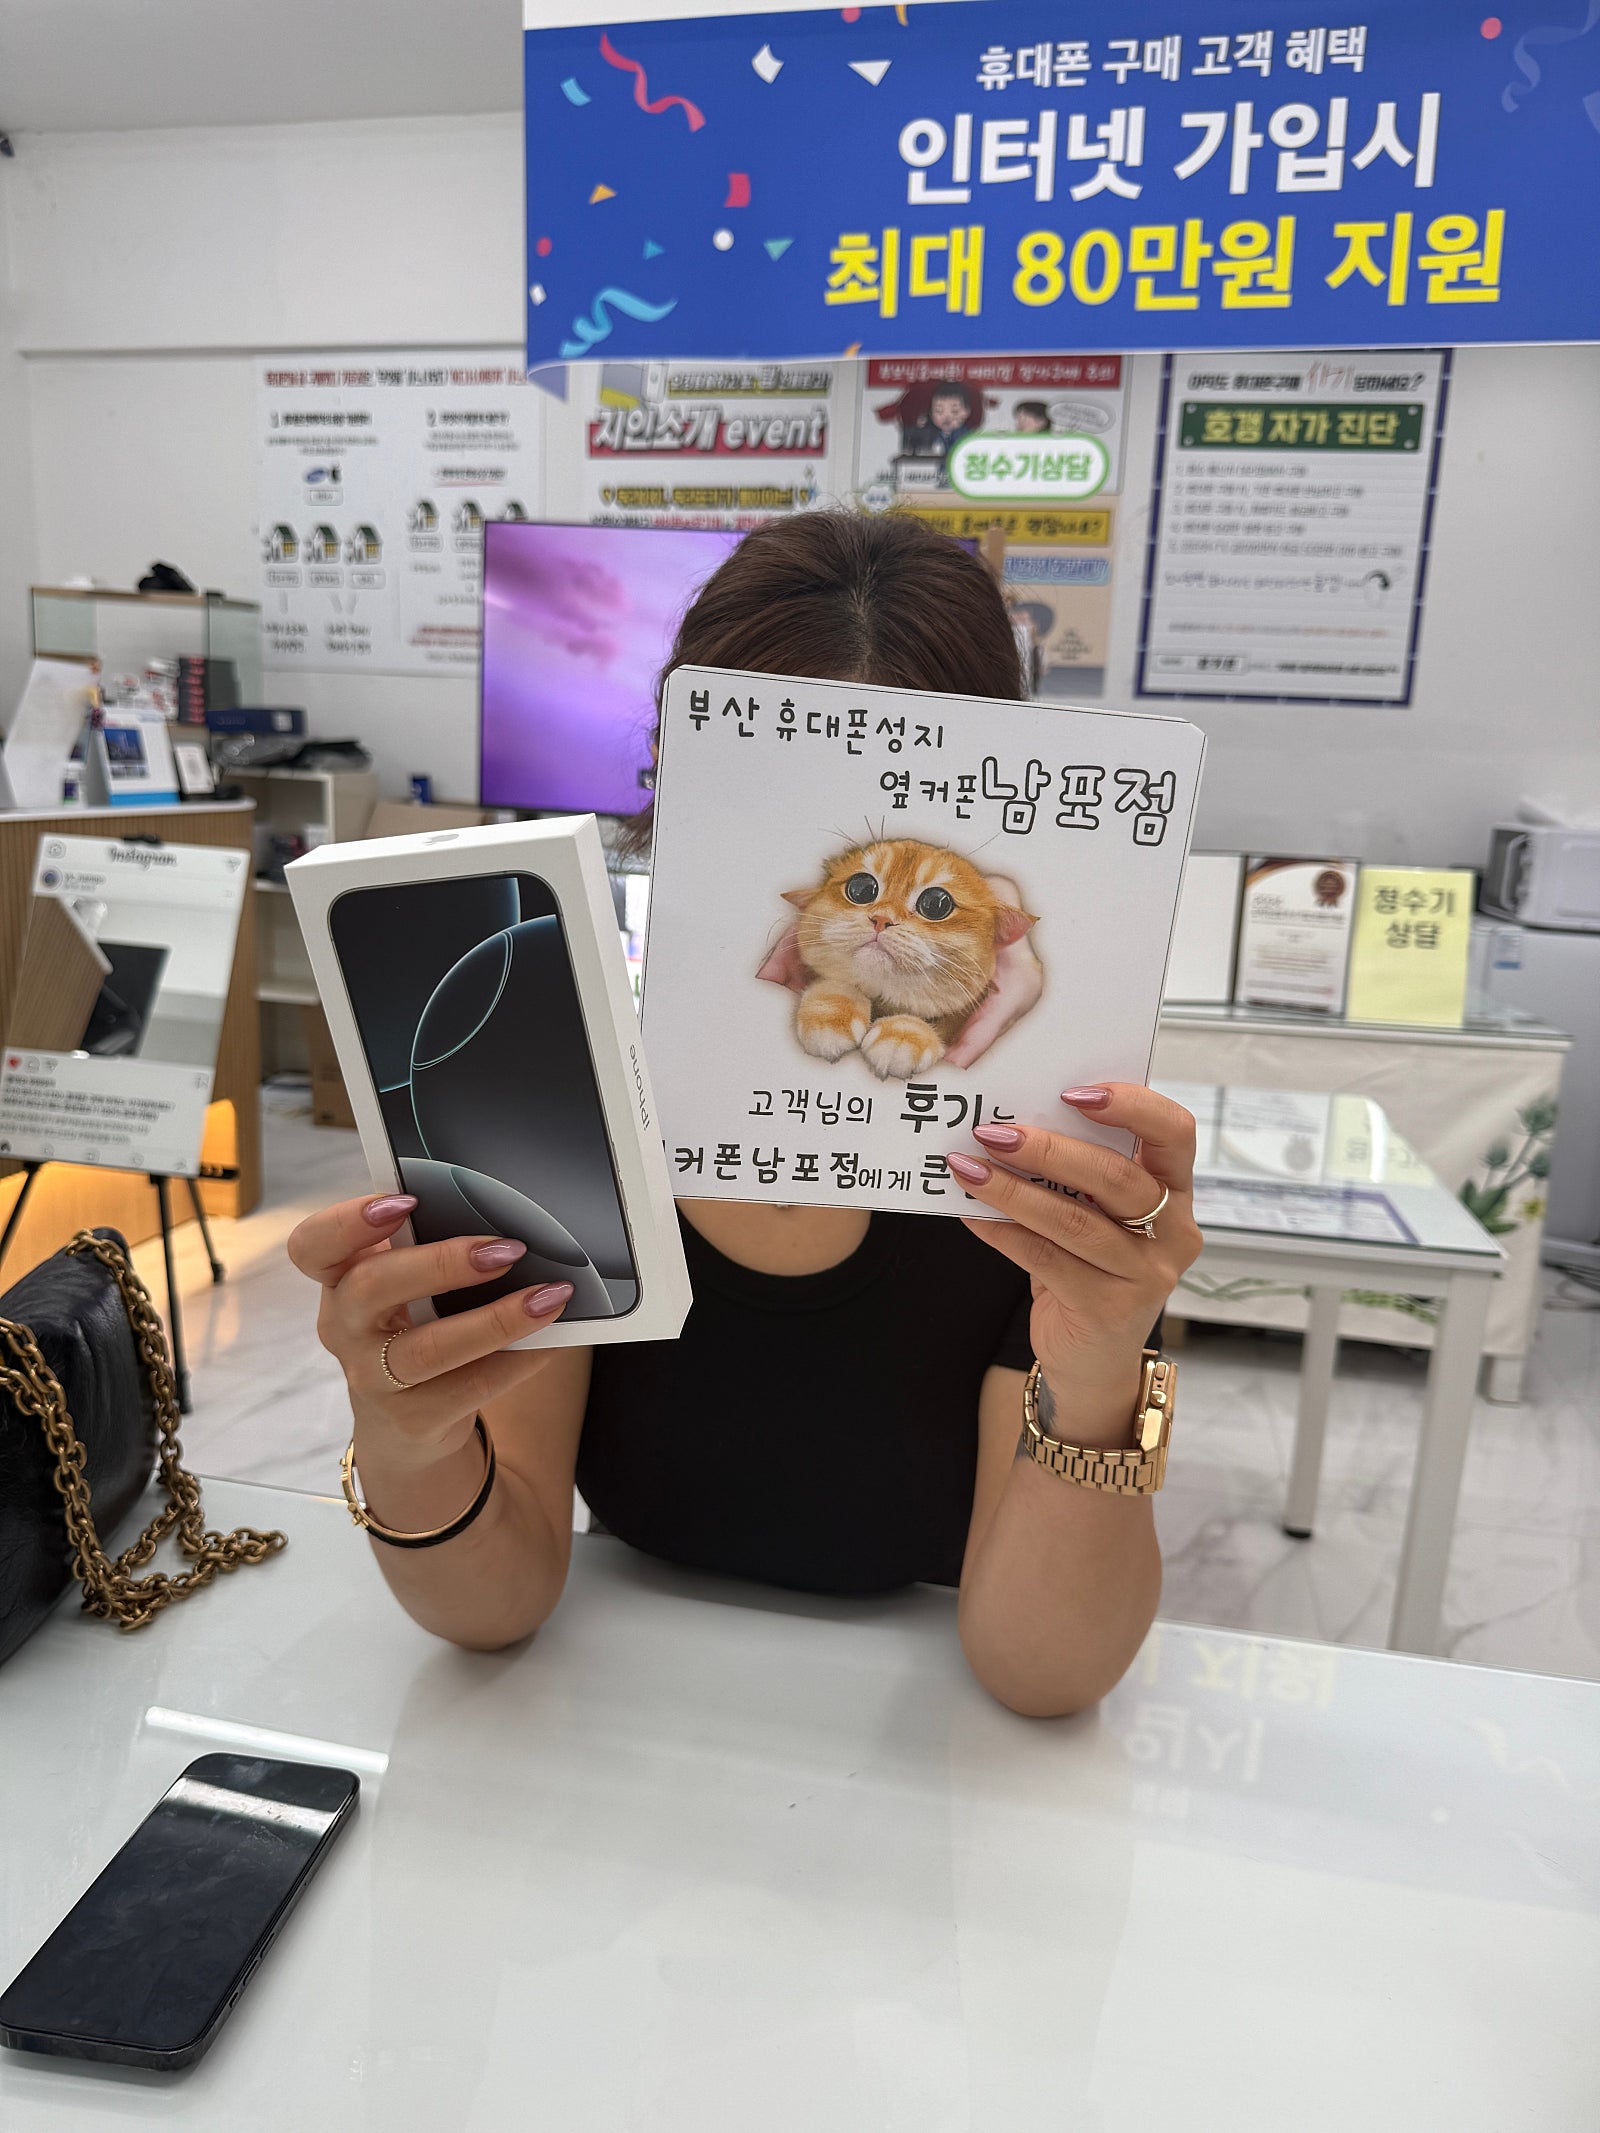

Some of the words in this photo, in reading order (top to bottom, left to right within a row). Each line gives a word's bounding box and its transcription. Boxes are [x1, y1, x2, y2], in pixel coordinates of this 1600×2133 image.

[976, 41, 1092, 91] 휴대폰
[1102, 36, 1182, 85] 구매
[1191, 30, 1275, 78] 고객
[1285, 25, 1367, 75] 혜택
[898, 105, 1146, 206] 인터넷
[1173, 92, 1441, 195] 가입시
[825, 225, 984, 318] 최대
[1012, 215, 1295, 311] 80만원
[1326, 209, 1505, 305] 지원
[594, 407, 722, 451] 지인소개
[724, 409, 826, 450] event
[1202, 411, 1263, 443] 호갱
[1269, 412, 1328, 443] 자가
[1337, 412, 1400, 445] 진단
[964, 452, 1092, 482] 정수기상담
[688, 689, 760, 738] 부산
[776, 697, 944, 756] 휴대폰성지
[1373, 886, 1457, 917] 정수기
[1385, 921, 1441, 949] 상담
[748, 1088, 874, 1126] 고객님의
[662, 1140, 912, 1193] 커폰남포점에게
